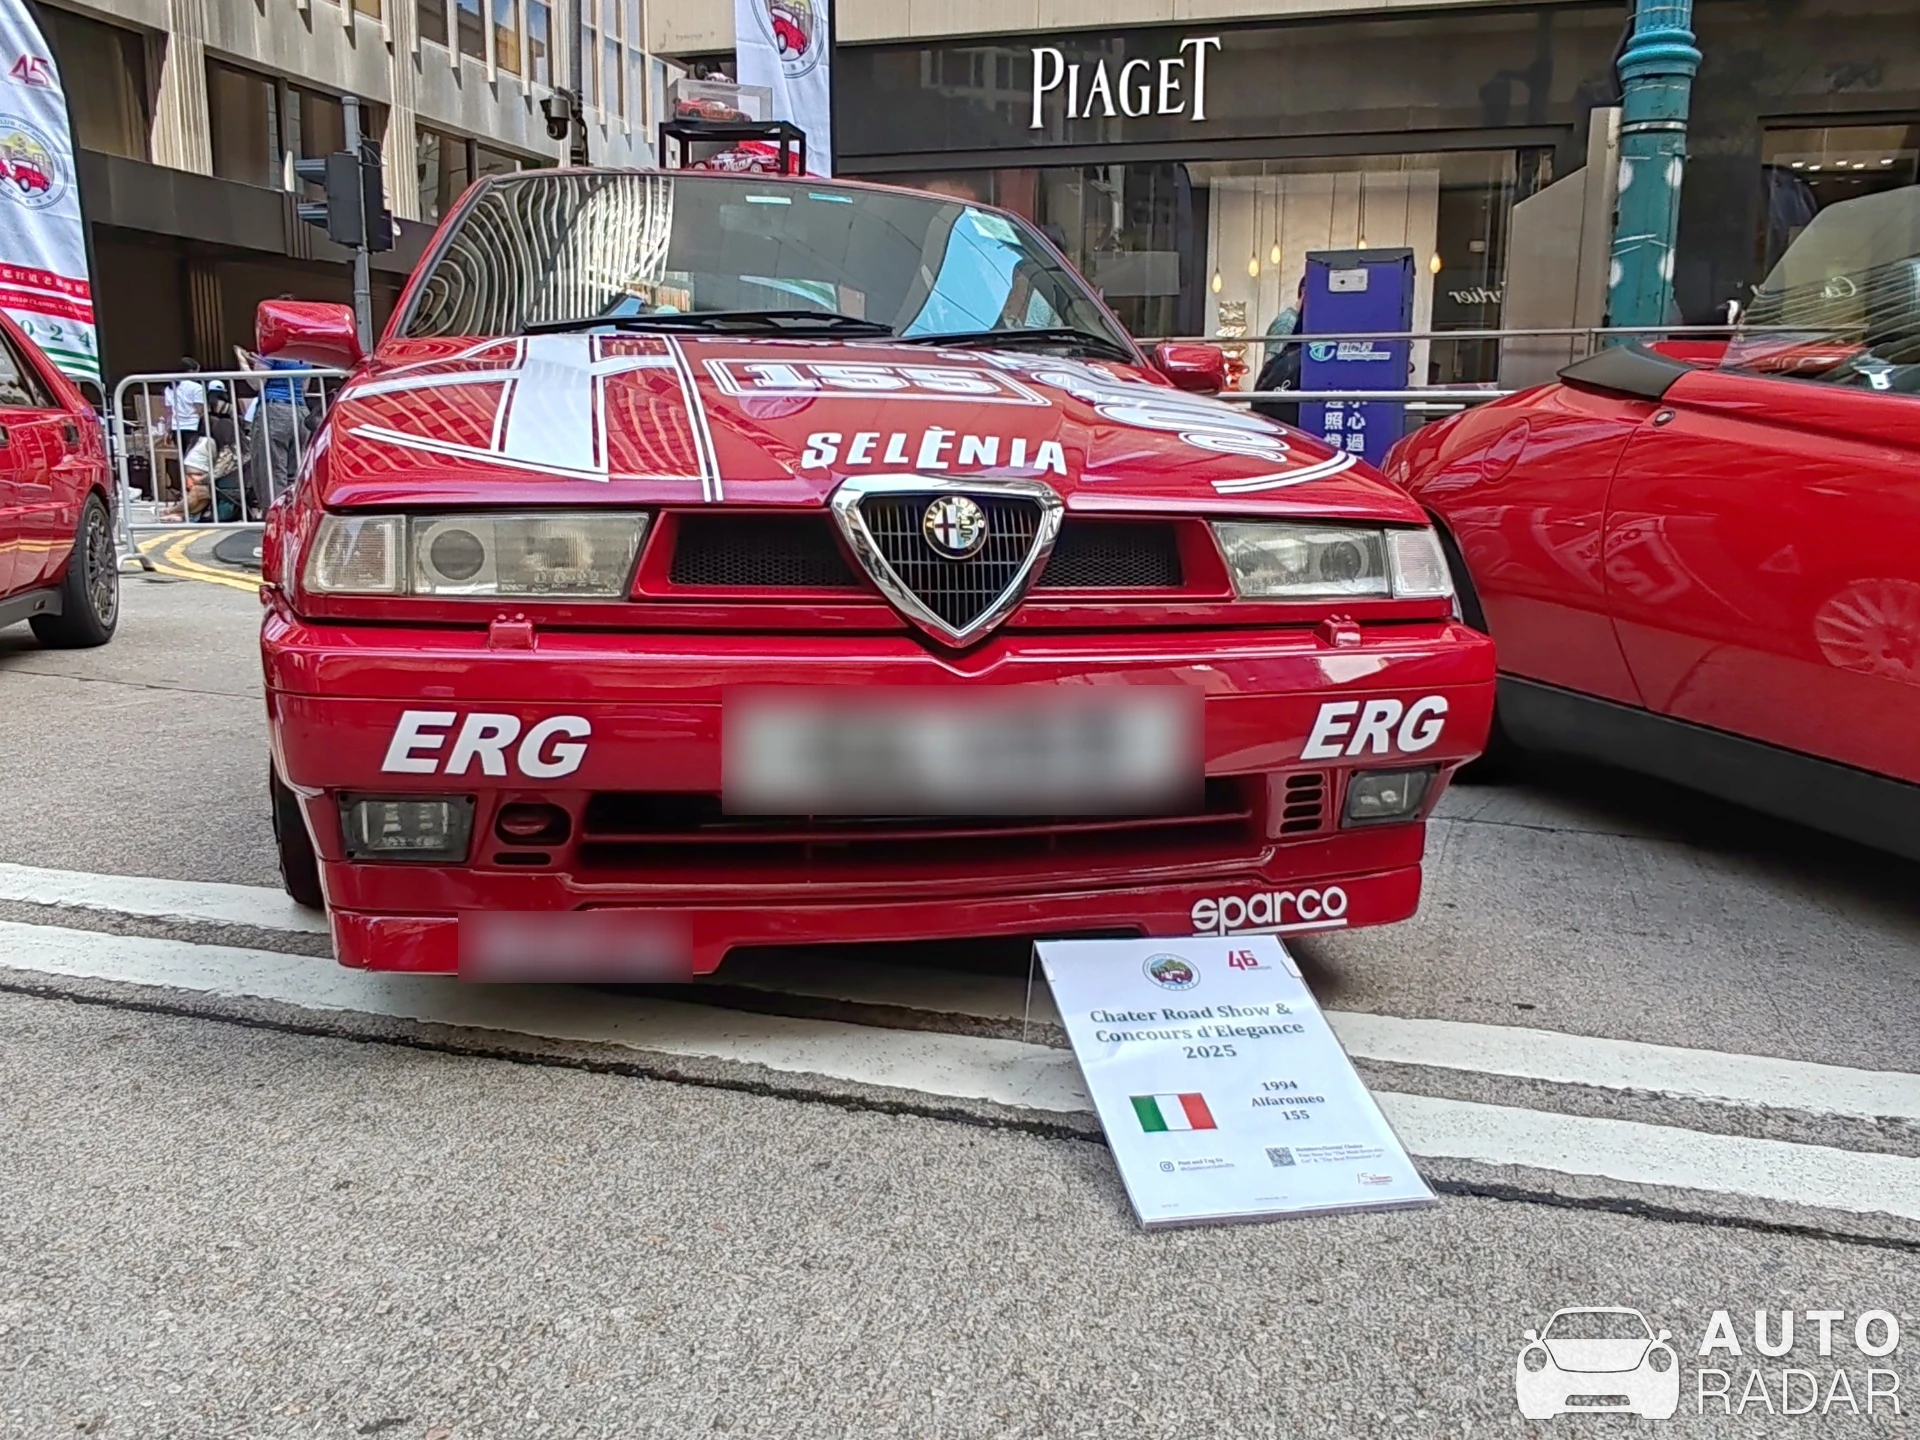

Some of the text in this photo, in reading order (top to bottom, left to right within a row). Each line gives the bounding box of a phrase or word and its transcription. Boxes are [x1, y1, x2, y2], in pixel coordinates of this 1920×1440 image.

[8, 54, 50, 85] 45
[1029, 37, 1221, 129] PIAGET
[744, 363, 1003, 394] 155
[801, 426, 1068, 475] SELÈNIA
[1300, 695, 1449, 760] ERG
[380, 709, 592, 779] ERG
[1191, 886, 1348, 937] sparco
[1090, 1002, 1293, 1025] Chater Road Show &
[1095, 1021, 1305, 1043] Concours d'Elegance
[1182, 1044, 1238, 1059] 2025
[1250, 1094, 1326, 1108] Alfaromeo
[1261, 1079, 1298, 1092] 1994
[1281, 1109, 1311, 1121] 155
